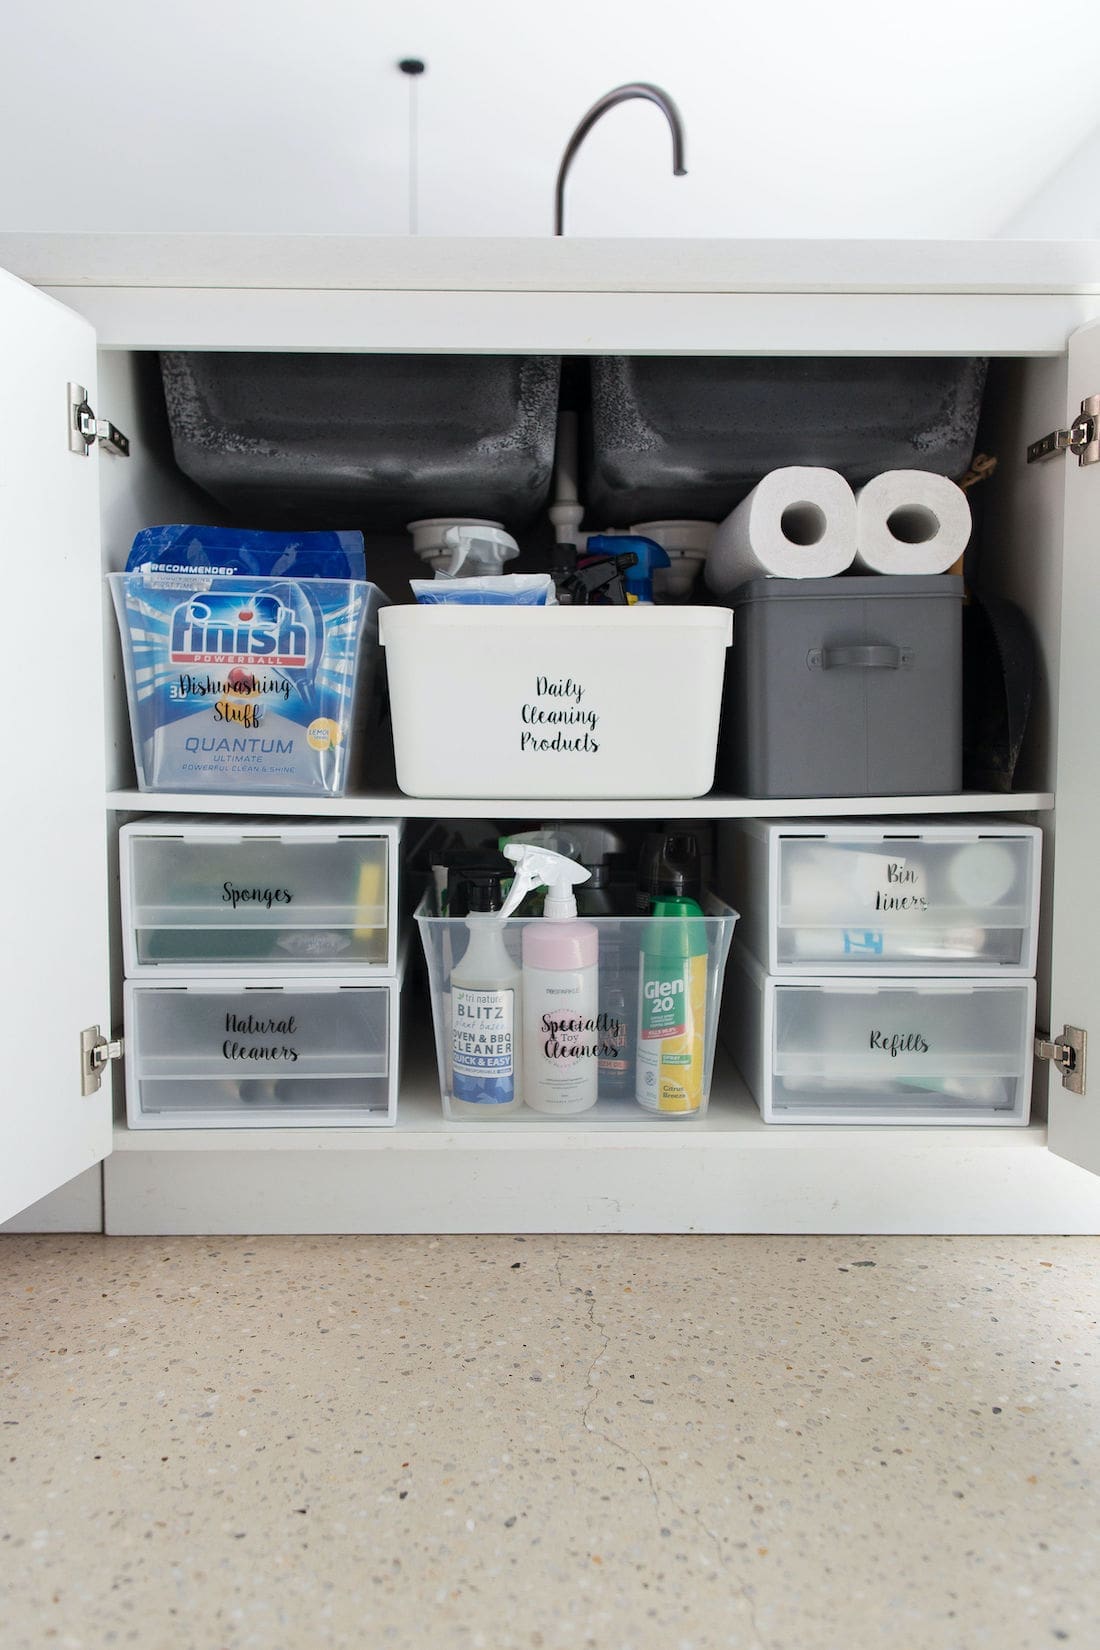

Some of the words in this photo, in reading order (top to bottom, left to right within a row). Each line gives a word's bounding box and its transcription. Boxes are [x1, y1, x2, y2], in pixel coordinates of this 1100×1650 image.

[171, 601, 307, 655] finish
[194, 655, 283, 665] POWERBALL
[180, 674, 291, 700] Dishwashing
[536, 676, 585, 703] Daily
[213, 701, 263, 728] Stuff
[521, 703, 599, 730] Cleaning
[185, 737, 294, 754] QUANTUM
[521, 731, 600, 753] Products
[213, 755, 263, 763] ULTIMATE
[231, 765, 260, 773] CLEAN
[269, 766, 296, 774] SHINE
[887, 863, 918, 884] Bin
[222, 882, 293, 909] Sponges
[875, 891, 929, 911] Liners
[465, 993, 474, 1003] tri
[645, 979, 684, 999] Glen
[457, 1004, 504, 1019] BLITZ
[651, 996, 674, 1014] 20
[225, 1013, 297, 1034] Natural
[541, 1013, 620, 1037] Specialty
[479, 1034, 487, 1043] &
[490, 1033, 511, 1043] BBQ
[561, 1033, 579, 1043] Toy
[870, 1030, 930, 1057] Refills
[222, 1040, 300, 1062] Cleaners
[544, 1040, 618, 1058] Cleaners
[478, 1057, 486, 1067] &
[487, 1056, 511, 1067] EASY
